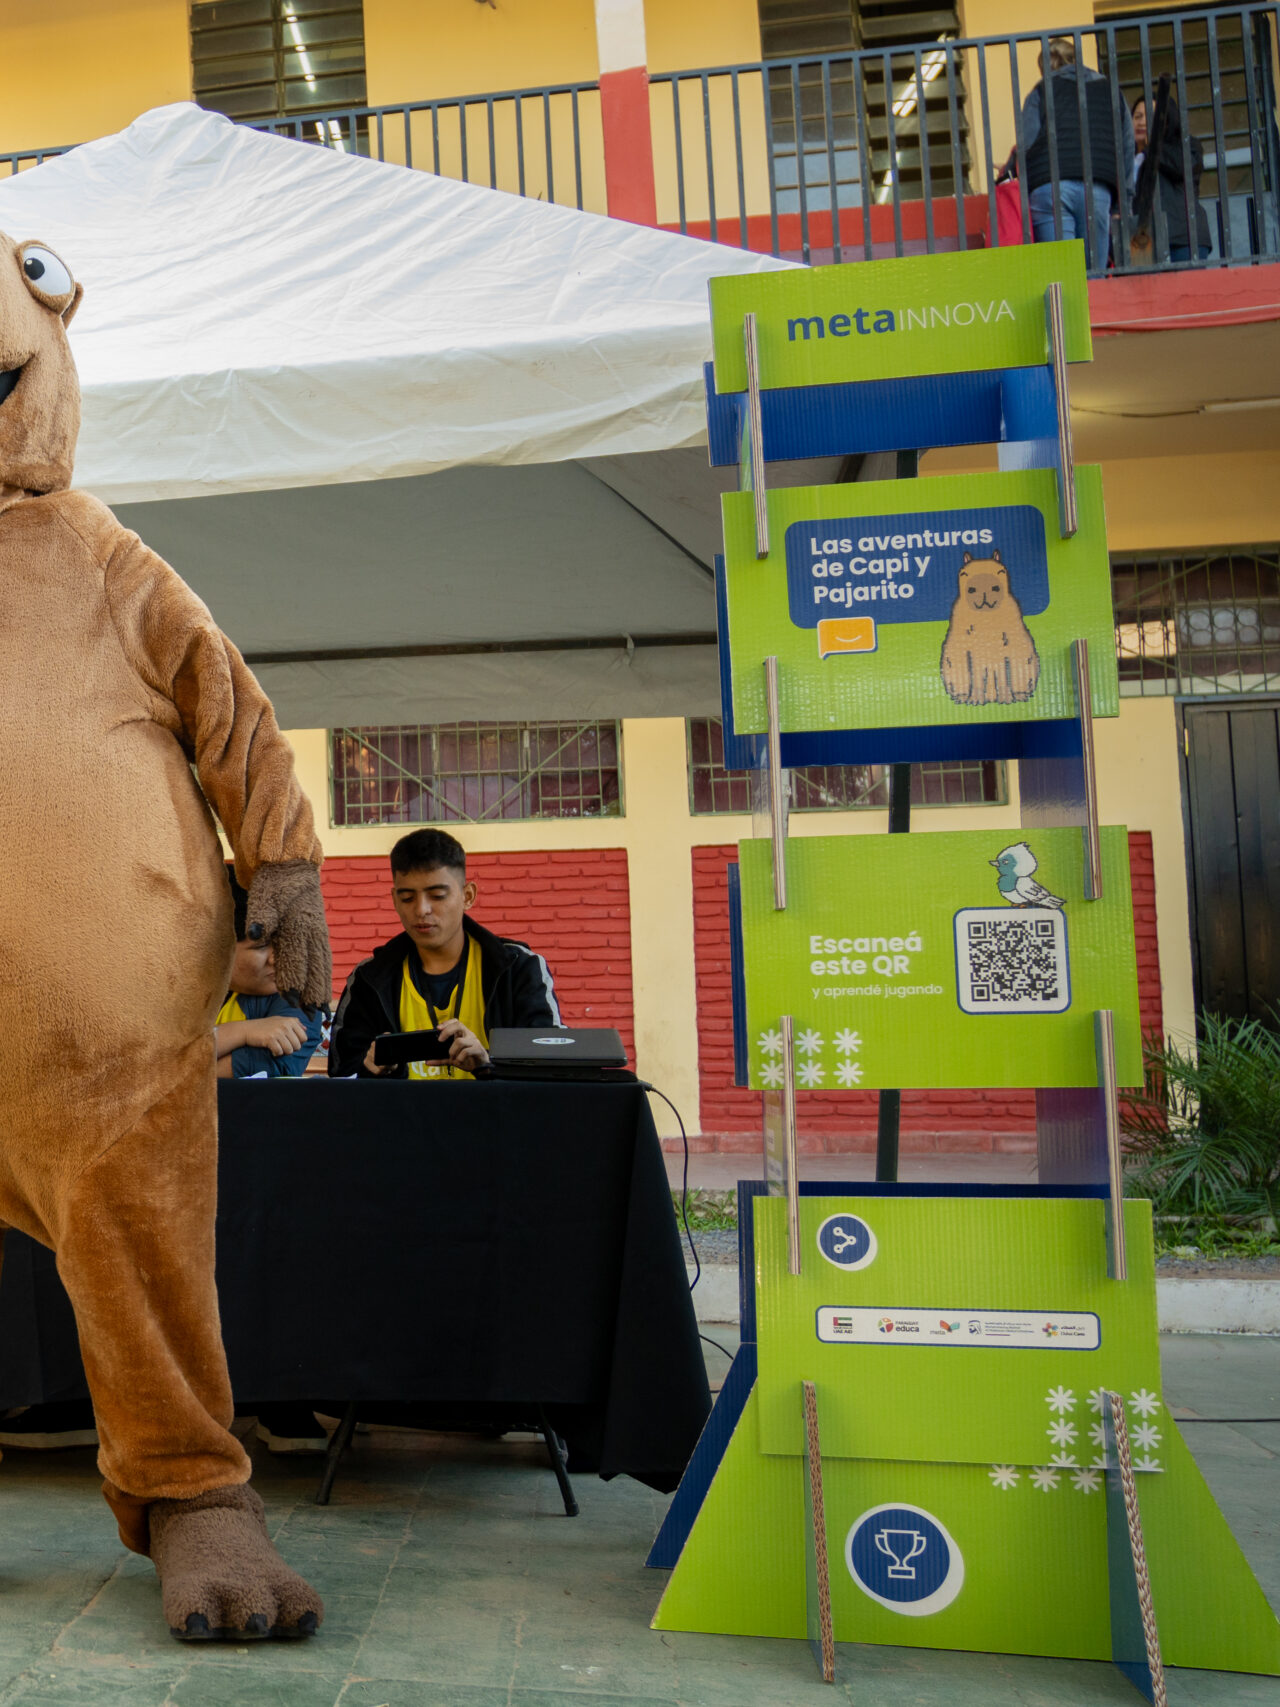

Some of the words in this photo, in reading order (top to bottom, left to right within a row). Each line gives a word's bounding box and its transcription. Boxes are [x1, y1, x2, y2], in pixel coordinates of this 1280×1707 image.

[787, 299, 1015, 341] metaINNOVA
[810, 537, 853, 555] Las
[857, 528, 993, 551] aventuras
[811, 558, 844, 578] de
[849, 552, 910, 579] Capi
[913, 555, 931, 577] y
[813, 579, 914, 608] Pajarito
[810, 930, 923, 954] Escaneá
[810, 956, 867, 976] este
[872, 955, 910, 977] QR
[812, 987, 820, 999] y
[823, 984, 882, 999] aprendé
[884, 984, 944, 998] jugando
[896, 1325, 920, 1333] educa
